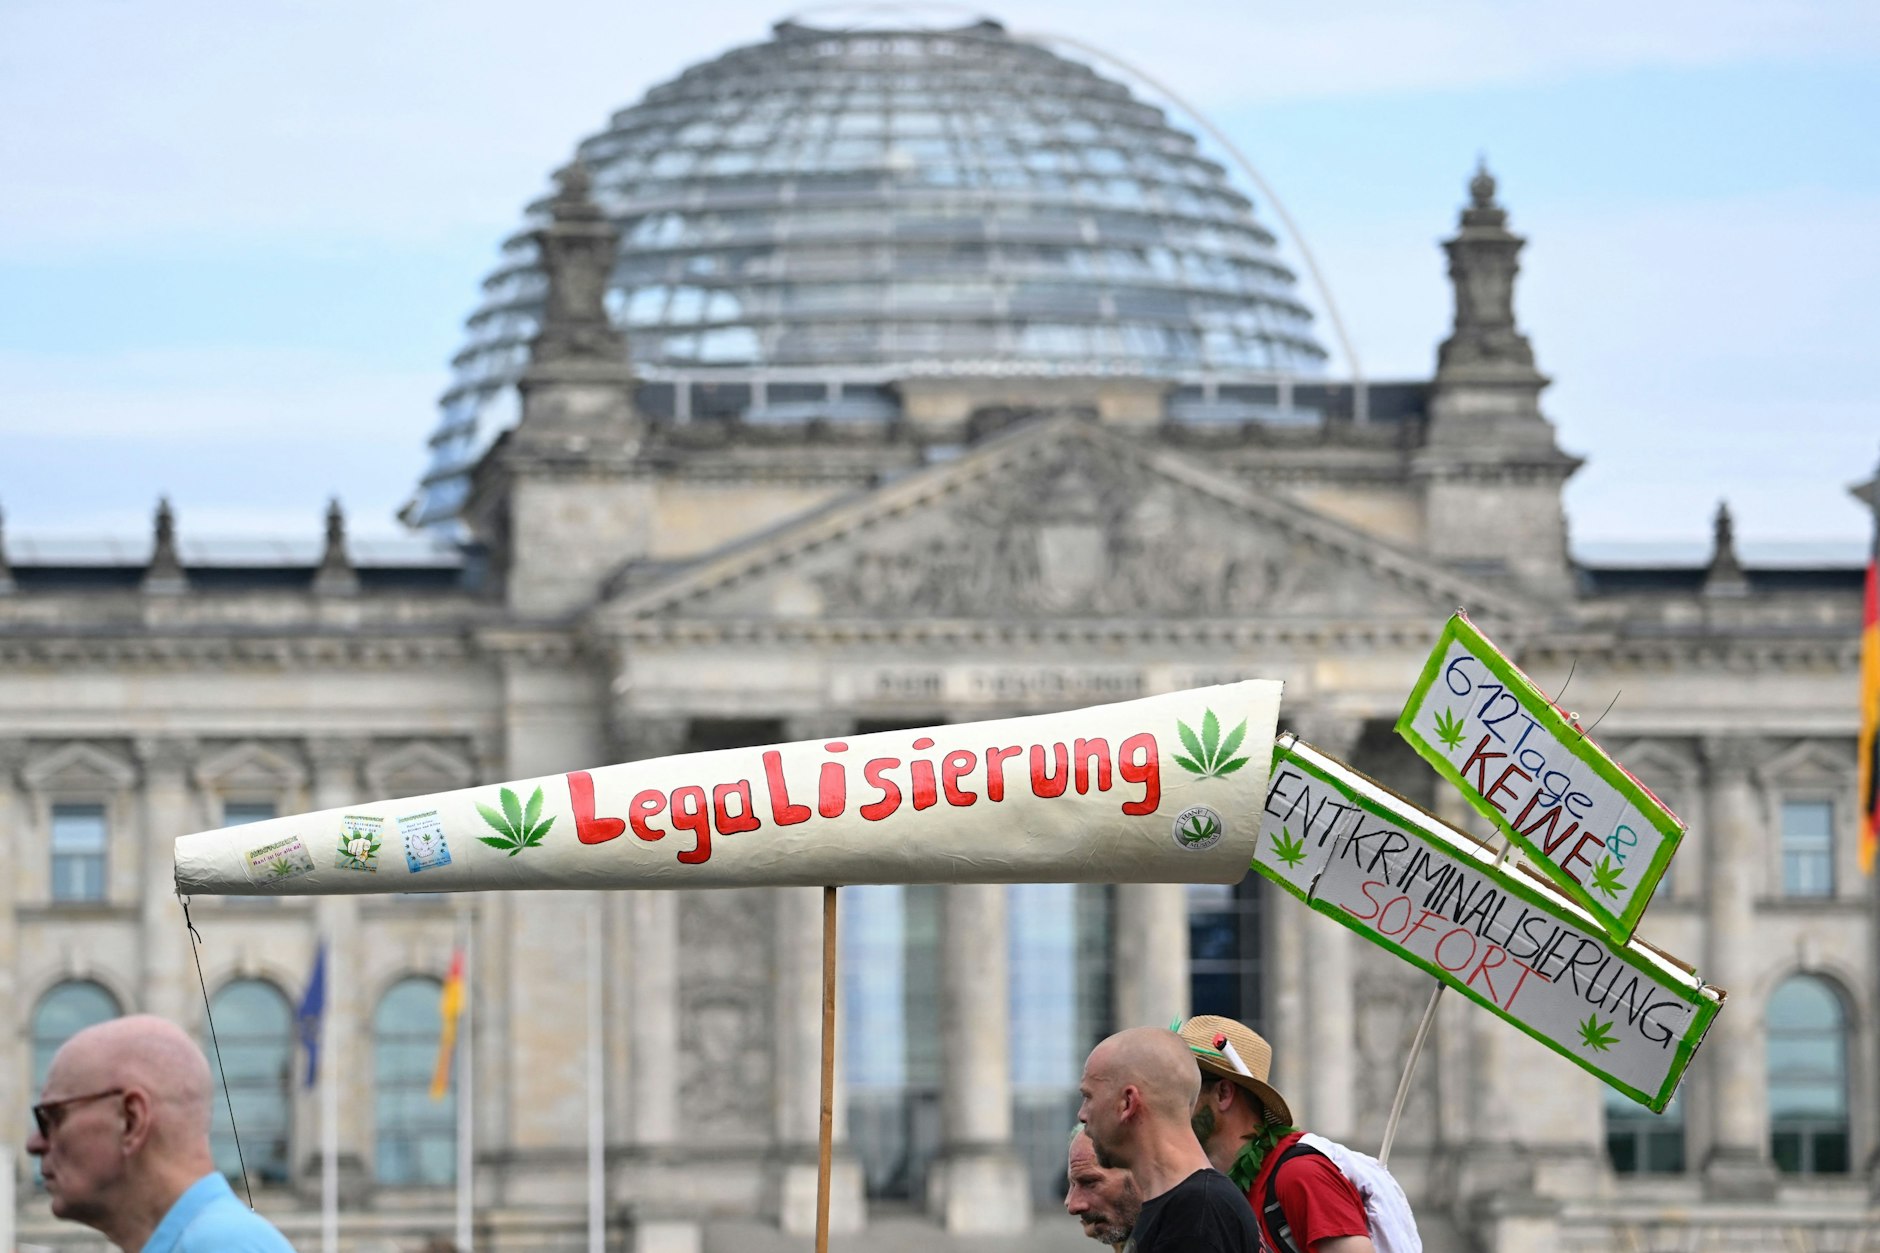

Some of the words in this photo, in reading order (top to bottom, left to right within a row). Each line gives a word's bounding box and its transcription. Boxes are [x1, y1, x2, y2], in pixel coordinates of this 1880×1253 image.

[1446, 656, 1520, 744] 612
[1512, 713, 1594, 820] Tage
[1460, 734, 1606, 886] KEINE
[1189, 834, 1218, 848] MUSEUM
[1264, 771, 1686, 1050] ENTKRIMINALISIERUNG
[1340, 881, 1551, 1013] SOFORT
